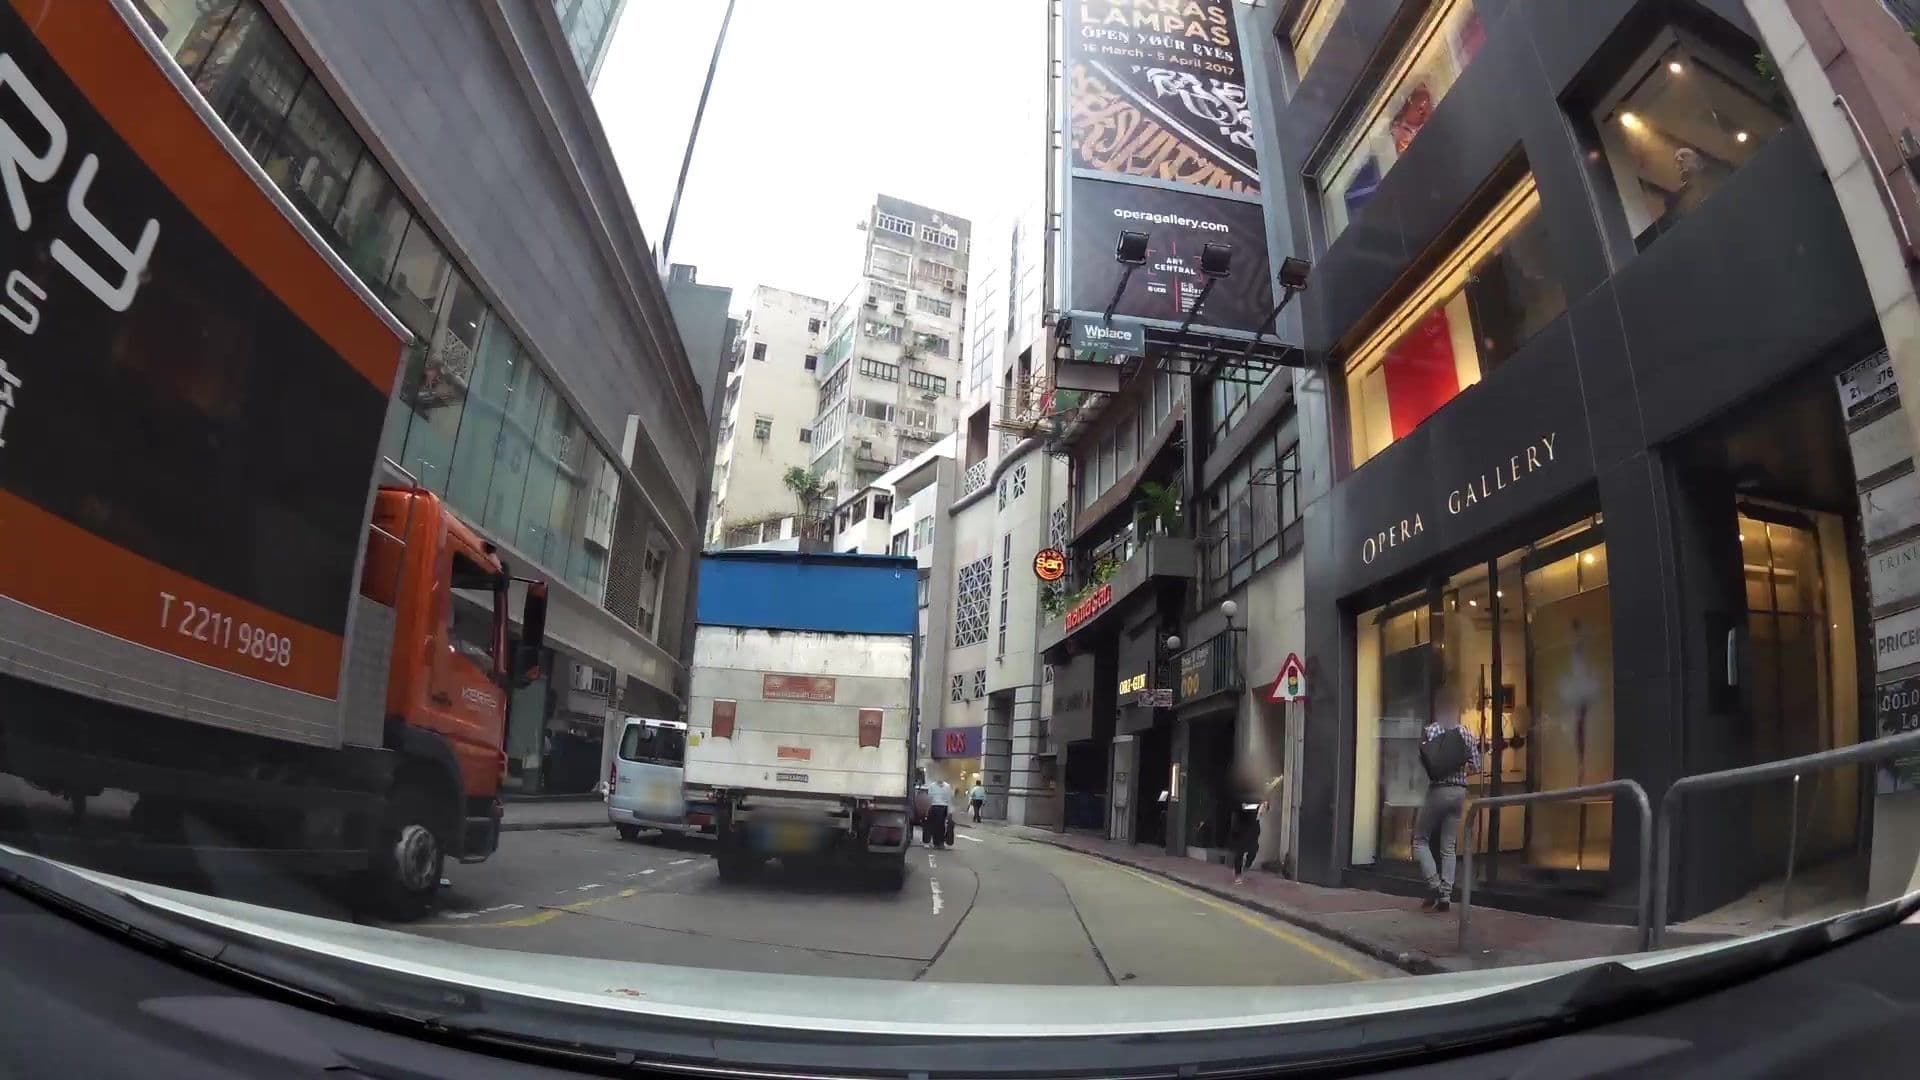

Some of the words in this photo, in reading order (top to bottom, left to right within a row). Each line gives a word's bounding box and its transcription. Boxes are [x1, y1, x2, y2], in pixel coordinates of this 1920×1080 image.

[1080, 4, 1230, 46] LAMPAS
[1081, 26, 1129, 44] OPEN
[1137, 33, 1185, 50] YOUR
[1192, 43, 1234, 62] EYES
[1101, 45, 1144, 58] March
[1168, 56, 1201, 68] April
[1205, 61, 1235, 76] 2017
[1113, 208, 1229, 233] operagallery.com
[1154, 263, 1196, 275] CENTRAL
[1166, 257, 1184, 265] ART
[1084, 324, 1132, 341] Wplace
[1362, 512, 1424, 565] OPERA
[1447, 432, 1556, 515] GALLERY
[160, 592, 177, 628] T
[178, 601, 233, 649] 2211
[237, 622, 291, 667] 9898
